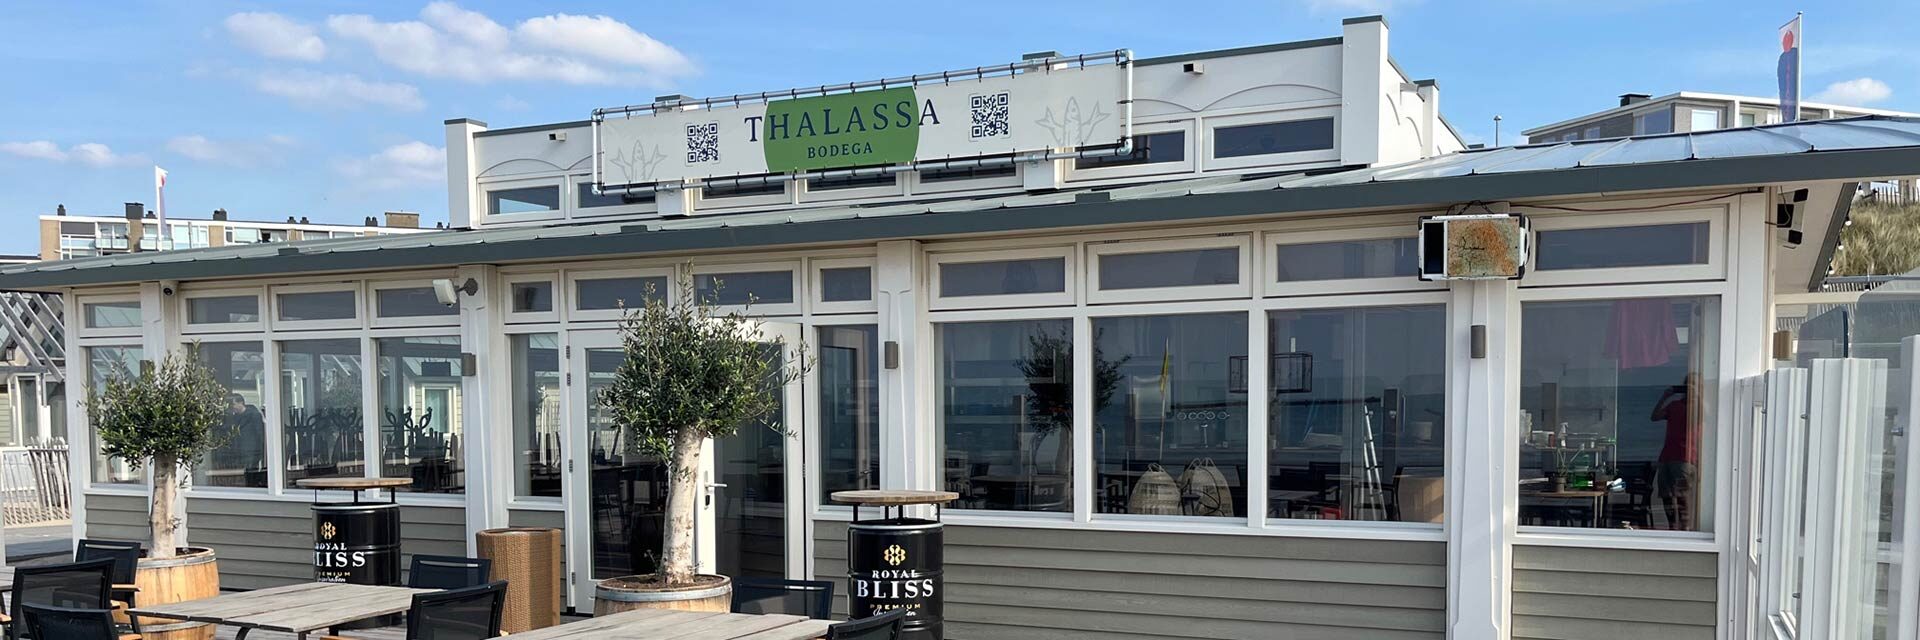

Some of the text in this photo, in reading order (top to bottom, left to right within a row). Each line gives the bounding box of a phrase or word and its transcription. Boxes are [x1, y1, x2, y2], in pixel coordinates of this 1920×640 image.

[744, 98, 940, 142] THALASSA
[808, 142, 873, 158] BODEGA
[313, 551, 365, 567] LISS
[872, 569, 917, 579] ROYAL
[857, 579, 933, 598] BLISS
